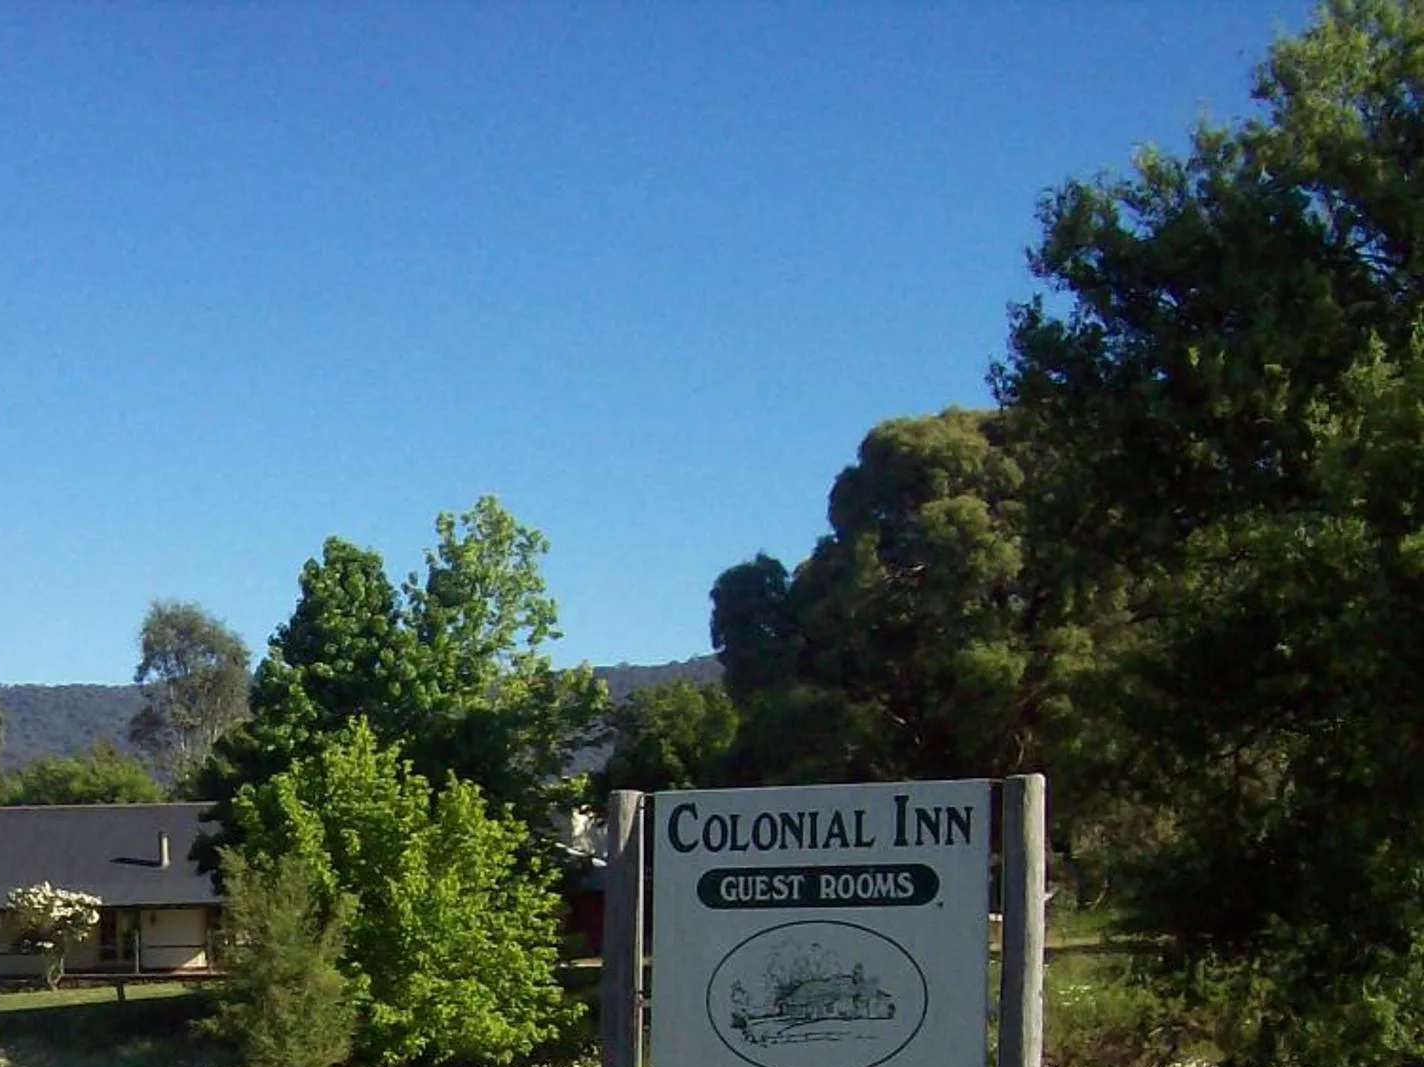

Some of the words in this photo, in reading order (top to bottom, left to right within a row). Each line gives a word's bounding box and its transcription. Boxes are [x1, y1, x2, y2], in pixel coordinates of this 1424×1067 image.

[667, 802, 876, 853] COLONIAL
[893, 794, 974, 847] INN
[719, 873, 806, 902] GUEST
[819, 871, 915, 900] ROOMS
